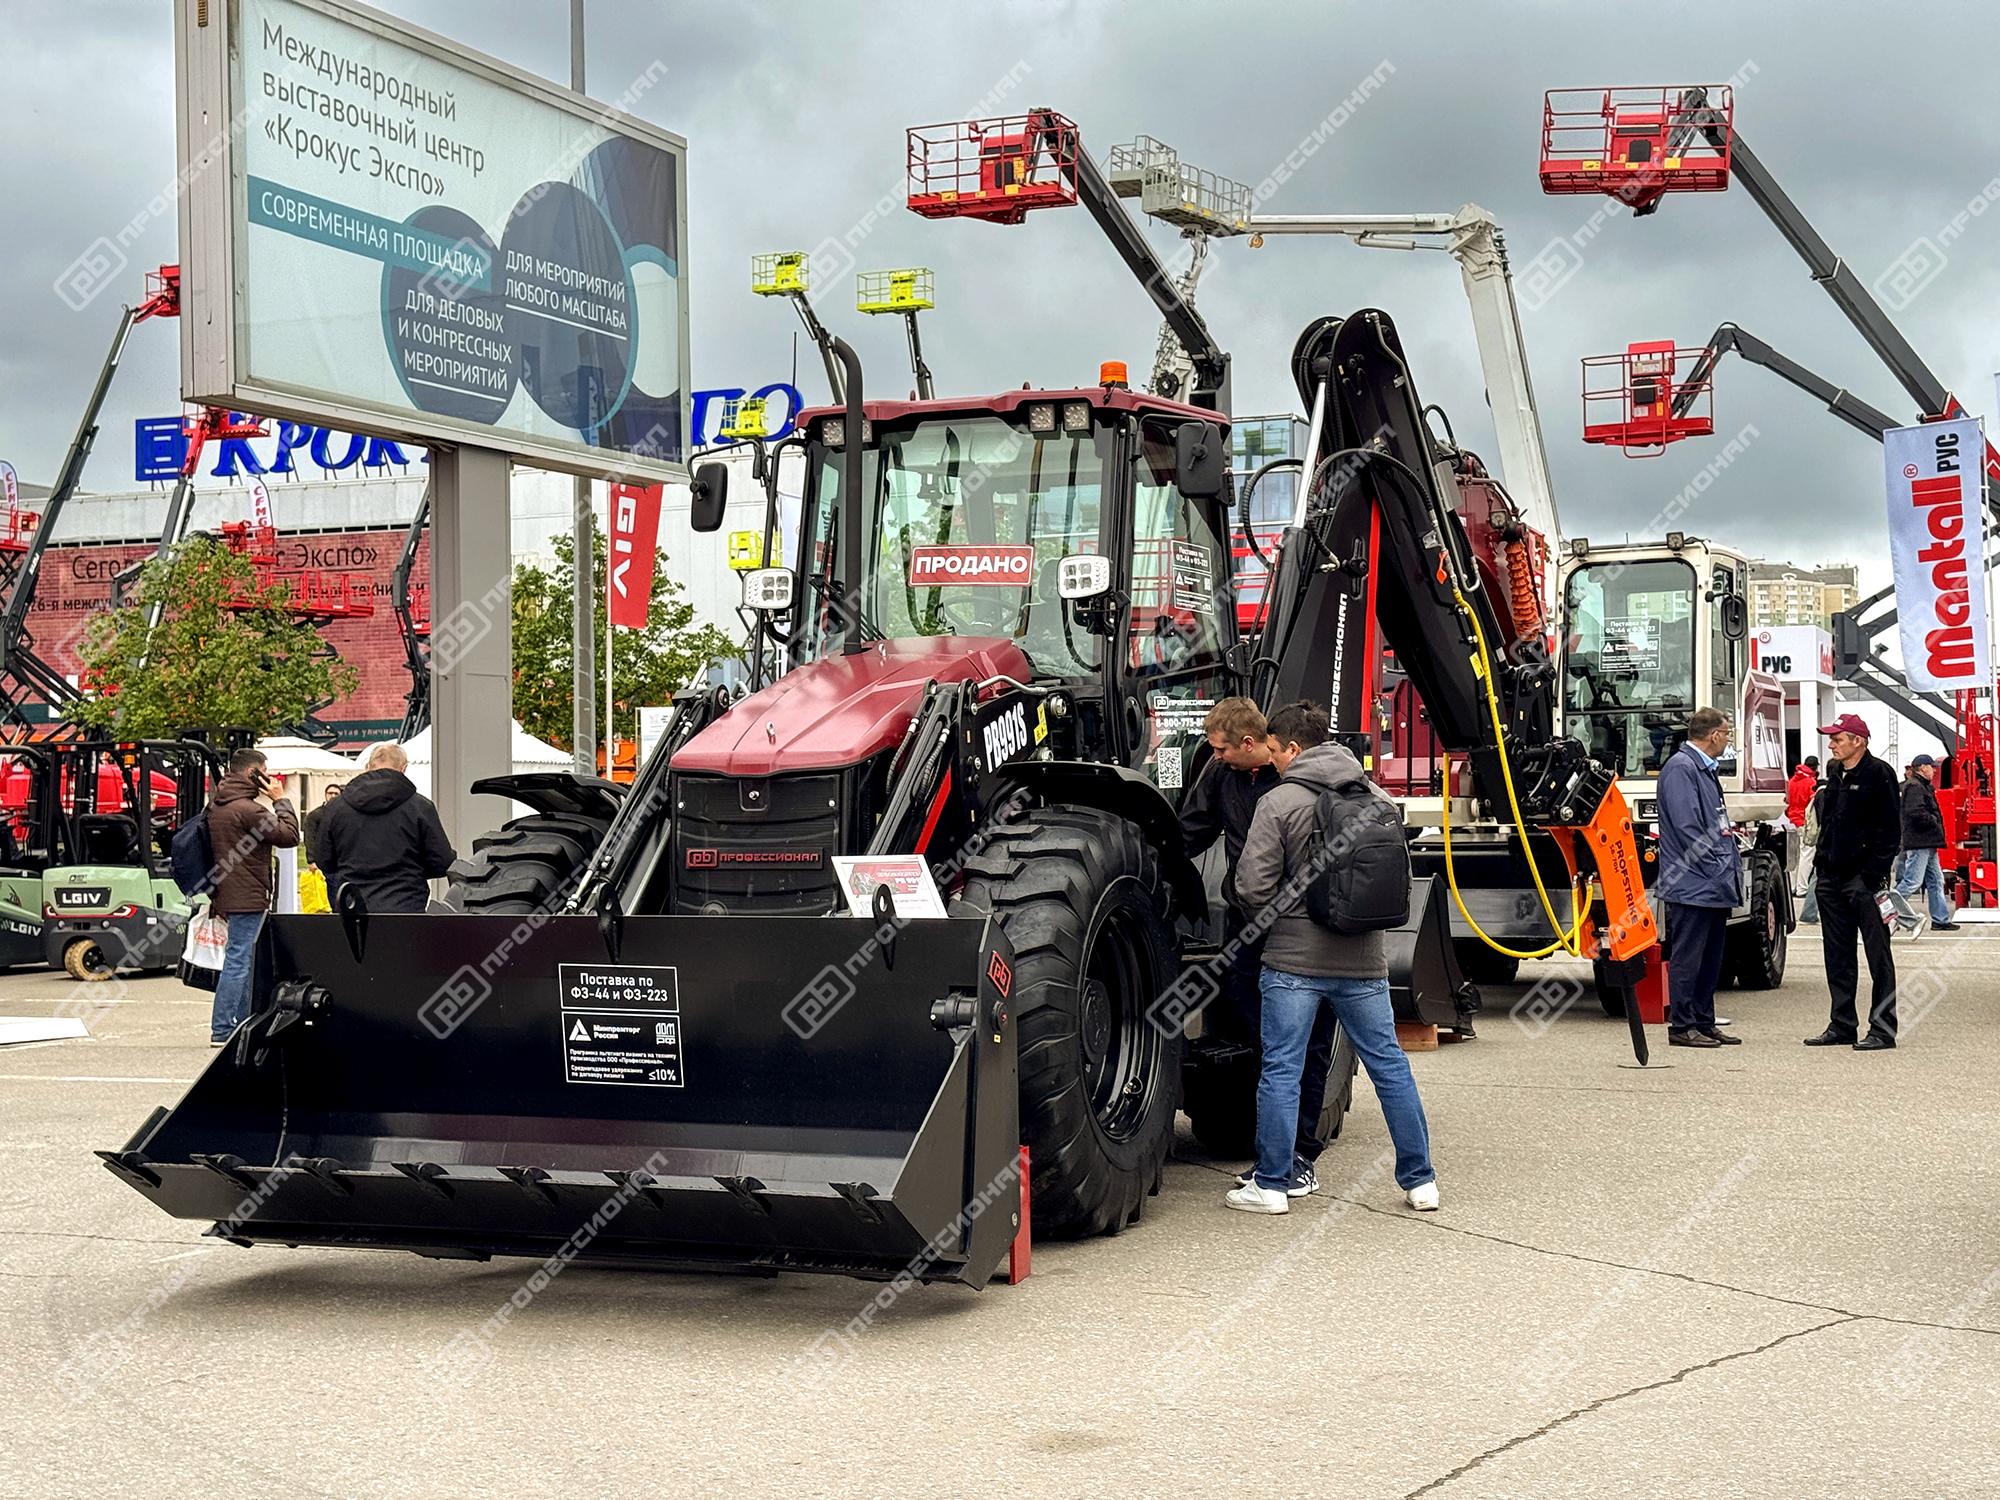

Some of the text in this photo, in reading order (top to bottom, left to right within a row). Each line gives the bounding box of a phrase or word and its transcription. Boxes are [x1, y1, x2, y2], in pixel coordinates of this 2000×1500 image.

[263, 18, 457, 122] Международный
[263, 72, 485, 178] выставочный центр
[264, 113, 446, 197] «Крокус Экспо»
[261, 190, 484, 280] СОВРЕМЕННАЯ ПЛОЩАДКА
[506, 249, 626, 303] ДЛЯ МЕРОПРИЯТИЙ
[405, 289, 504, 334] ДЛЯ ДЕЛОВЫХ
[505, 277, 627, 330] ЛЮБОГО МАСШТАБА
[398, 316, 512, 365] И КОНГРЕССНЫХ
[404, 349, 508, 392] МЕРОПРИЯТИЙ
[1935, 432, 1961, 473] РУС
[915, 555, 1028, 576] ПРОДАНО
[1911, 474, 1976, 679] mantall
[1330, 593, 1348, 730] ПРОФЕССИОНАЛ
[1761, 655, 1792, 674] РУС
[983, 701, 1027, 773] PB991S
[719, 852, 819, 863] ПРОФЕССИОНАЛ
[1614, 839, 1639, 924] PROFSTRIKE
[62, 892, 102, 904] LGIV
[10, 921, 42, 937] LGIV
[570, 986, 668, 1002] ФЗ-44 и ФЗ-223
[579, 972, 654, 987] Поставка по
